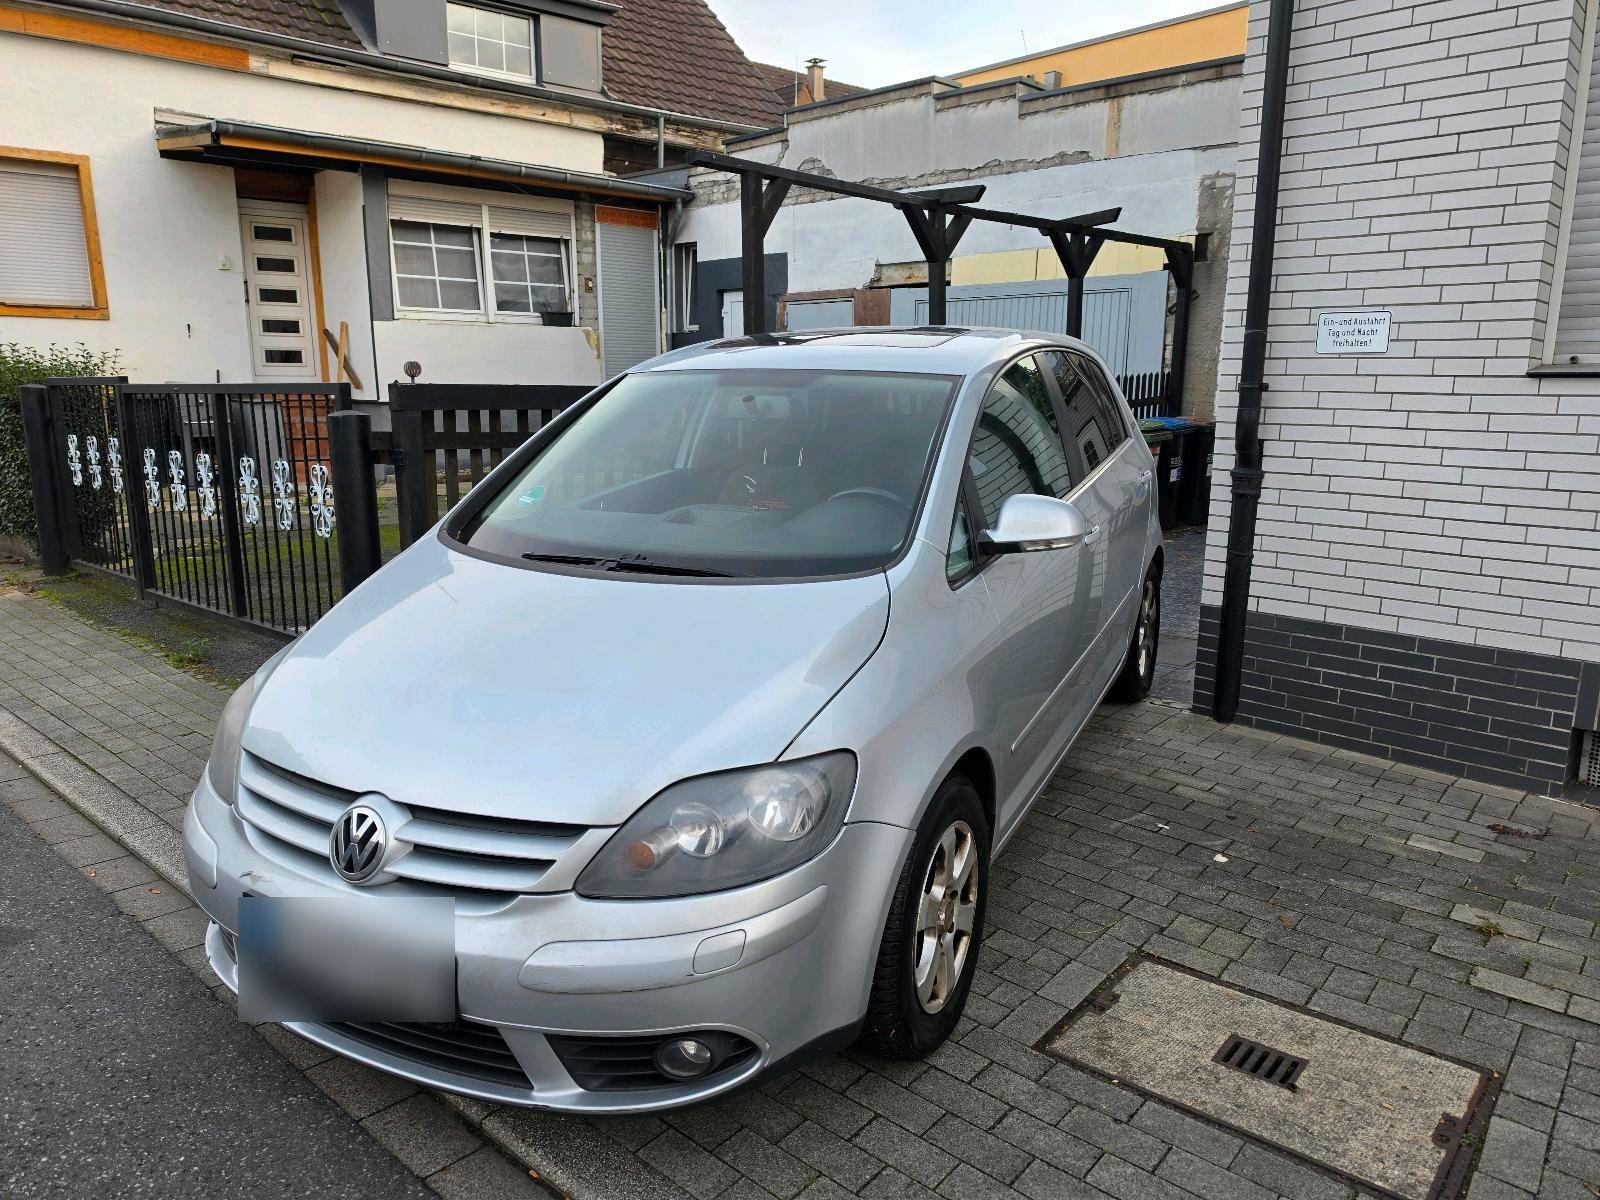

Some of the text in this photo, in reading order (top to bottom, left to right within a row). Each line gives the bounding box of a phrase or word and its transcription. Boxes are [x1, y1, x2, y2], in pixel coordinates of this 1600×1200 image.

[1353, 317, 1386, 325] Ausfahrt
[1328, 328, 1378, 338] Tag und Nacht
[1332, 339, 1372, 347] freihalten!
[332, 807, 386, 882] VW
